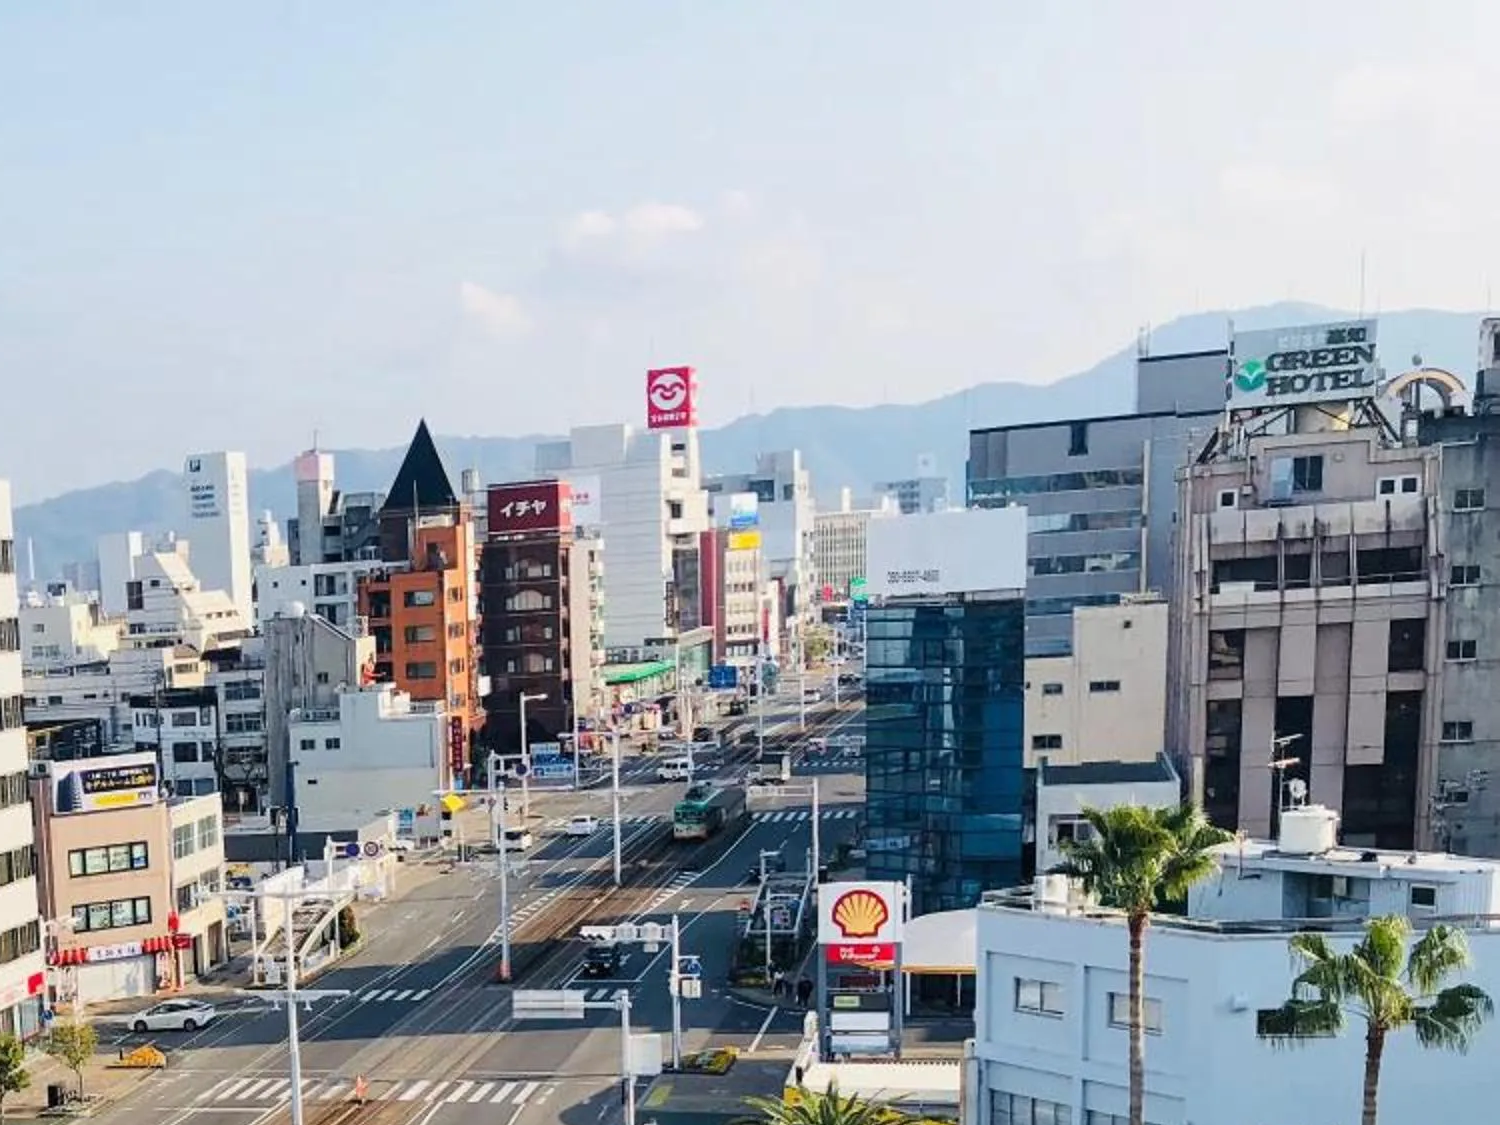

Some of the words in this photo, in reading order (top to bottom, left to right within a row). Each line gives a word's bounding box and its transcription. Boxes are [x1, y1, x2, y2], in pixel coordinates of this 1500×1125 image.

[1265, 343, 1377, 372] GREEN
[1265, 368, 1375, 397] HOTEL
[500, 500, 547, 518] イチヤ
